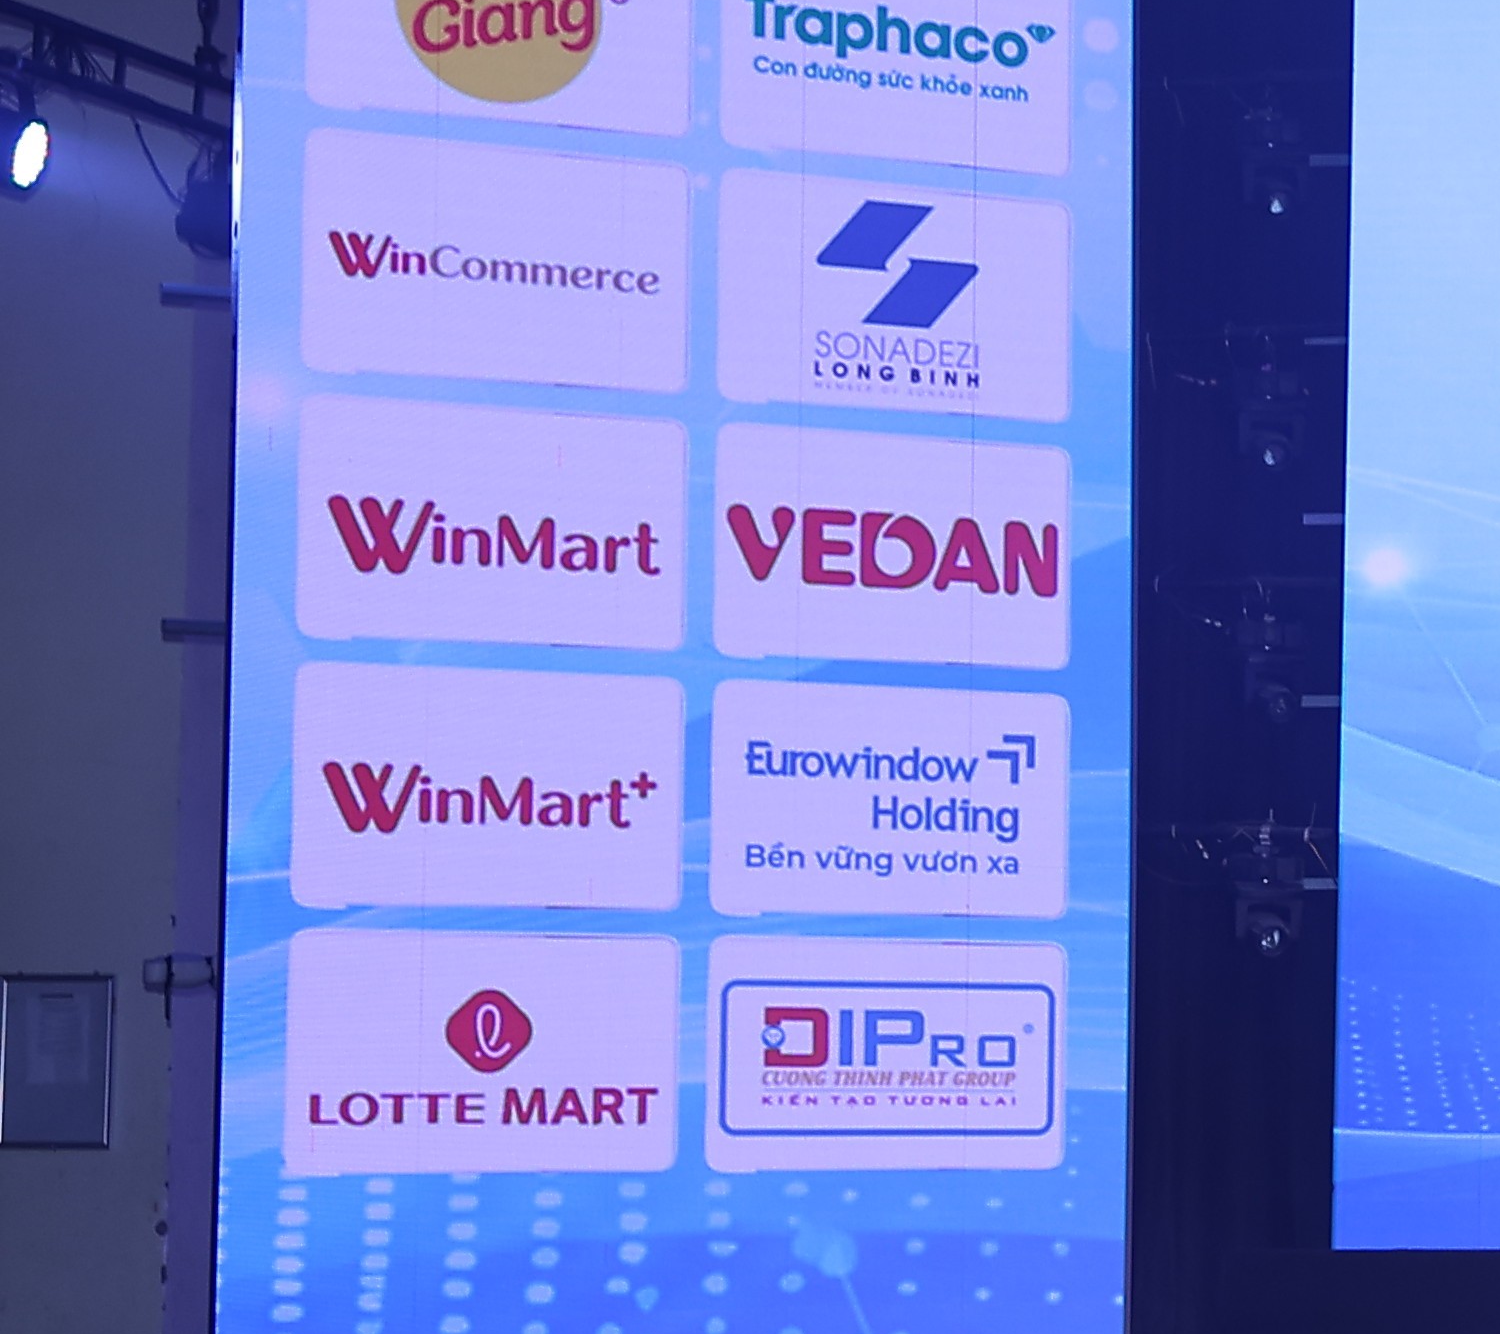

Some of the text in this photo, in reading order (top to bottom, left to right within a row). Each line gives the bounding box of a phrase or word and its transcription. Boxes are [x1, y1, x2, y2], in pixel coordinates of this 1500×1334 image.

[753, 55, 1029, 102] Con đường sức khỏe xanh
[327, 230, 660, 294] WinCommerce
[815, 330, 979, 369] SONADEZI
[814, 361, 895, 382] LONG
[327, 494, 662, 576] WinMart
[726, 503, 1059, 599] VEDAN
[745, 740, 978, 782] Eurowindow
[872, 795, 1020, 843] Holding
[815, 846, 893, 877] vững
[903, 850, 977, 873] vươn
[987, 855, 1019, 874] xa
[953, 1070, 1017, 1087] GROUP
[308, 1087, 660, 1127] LOTTE MART
